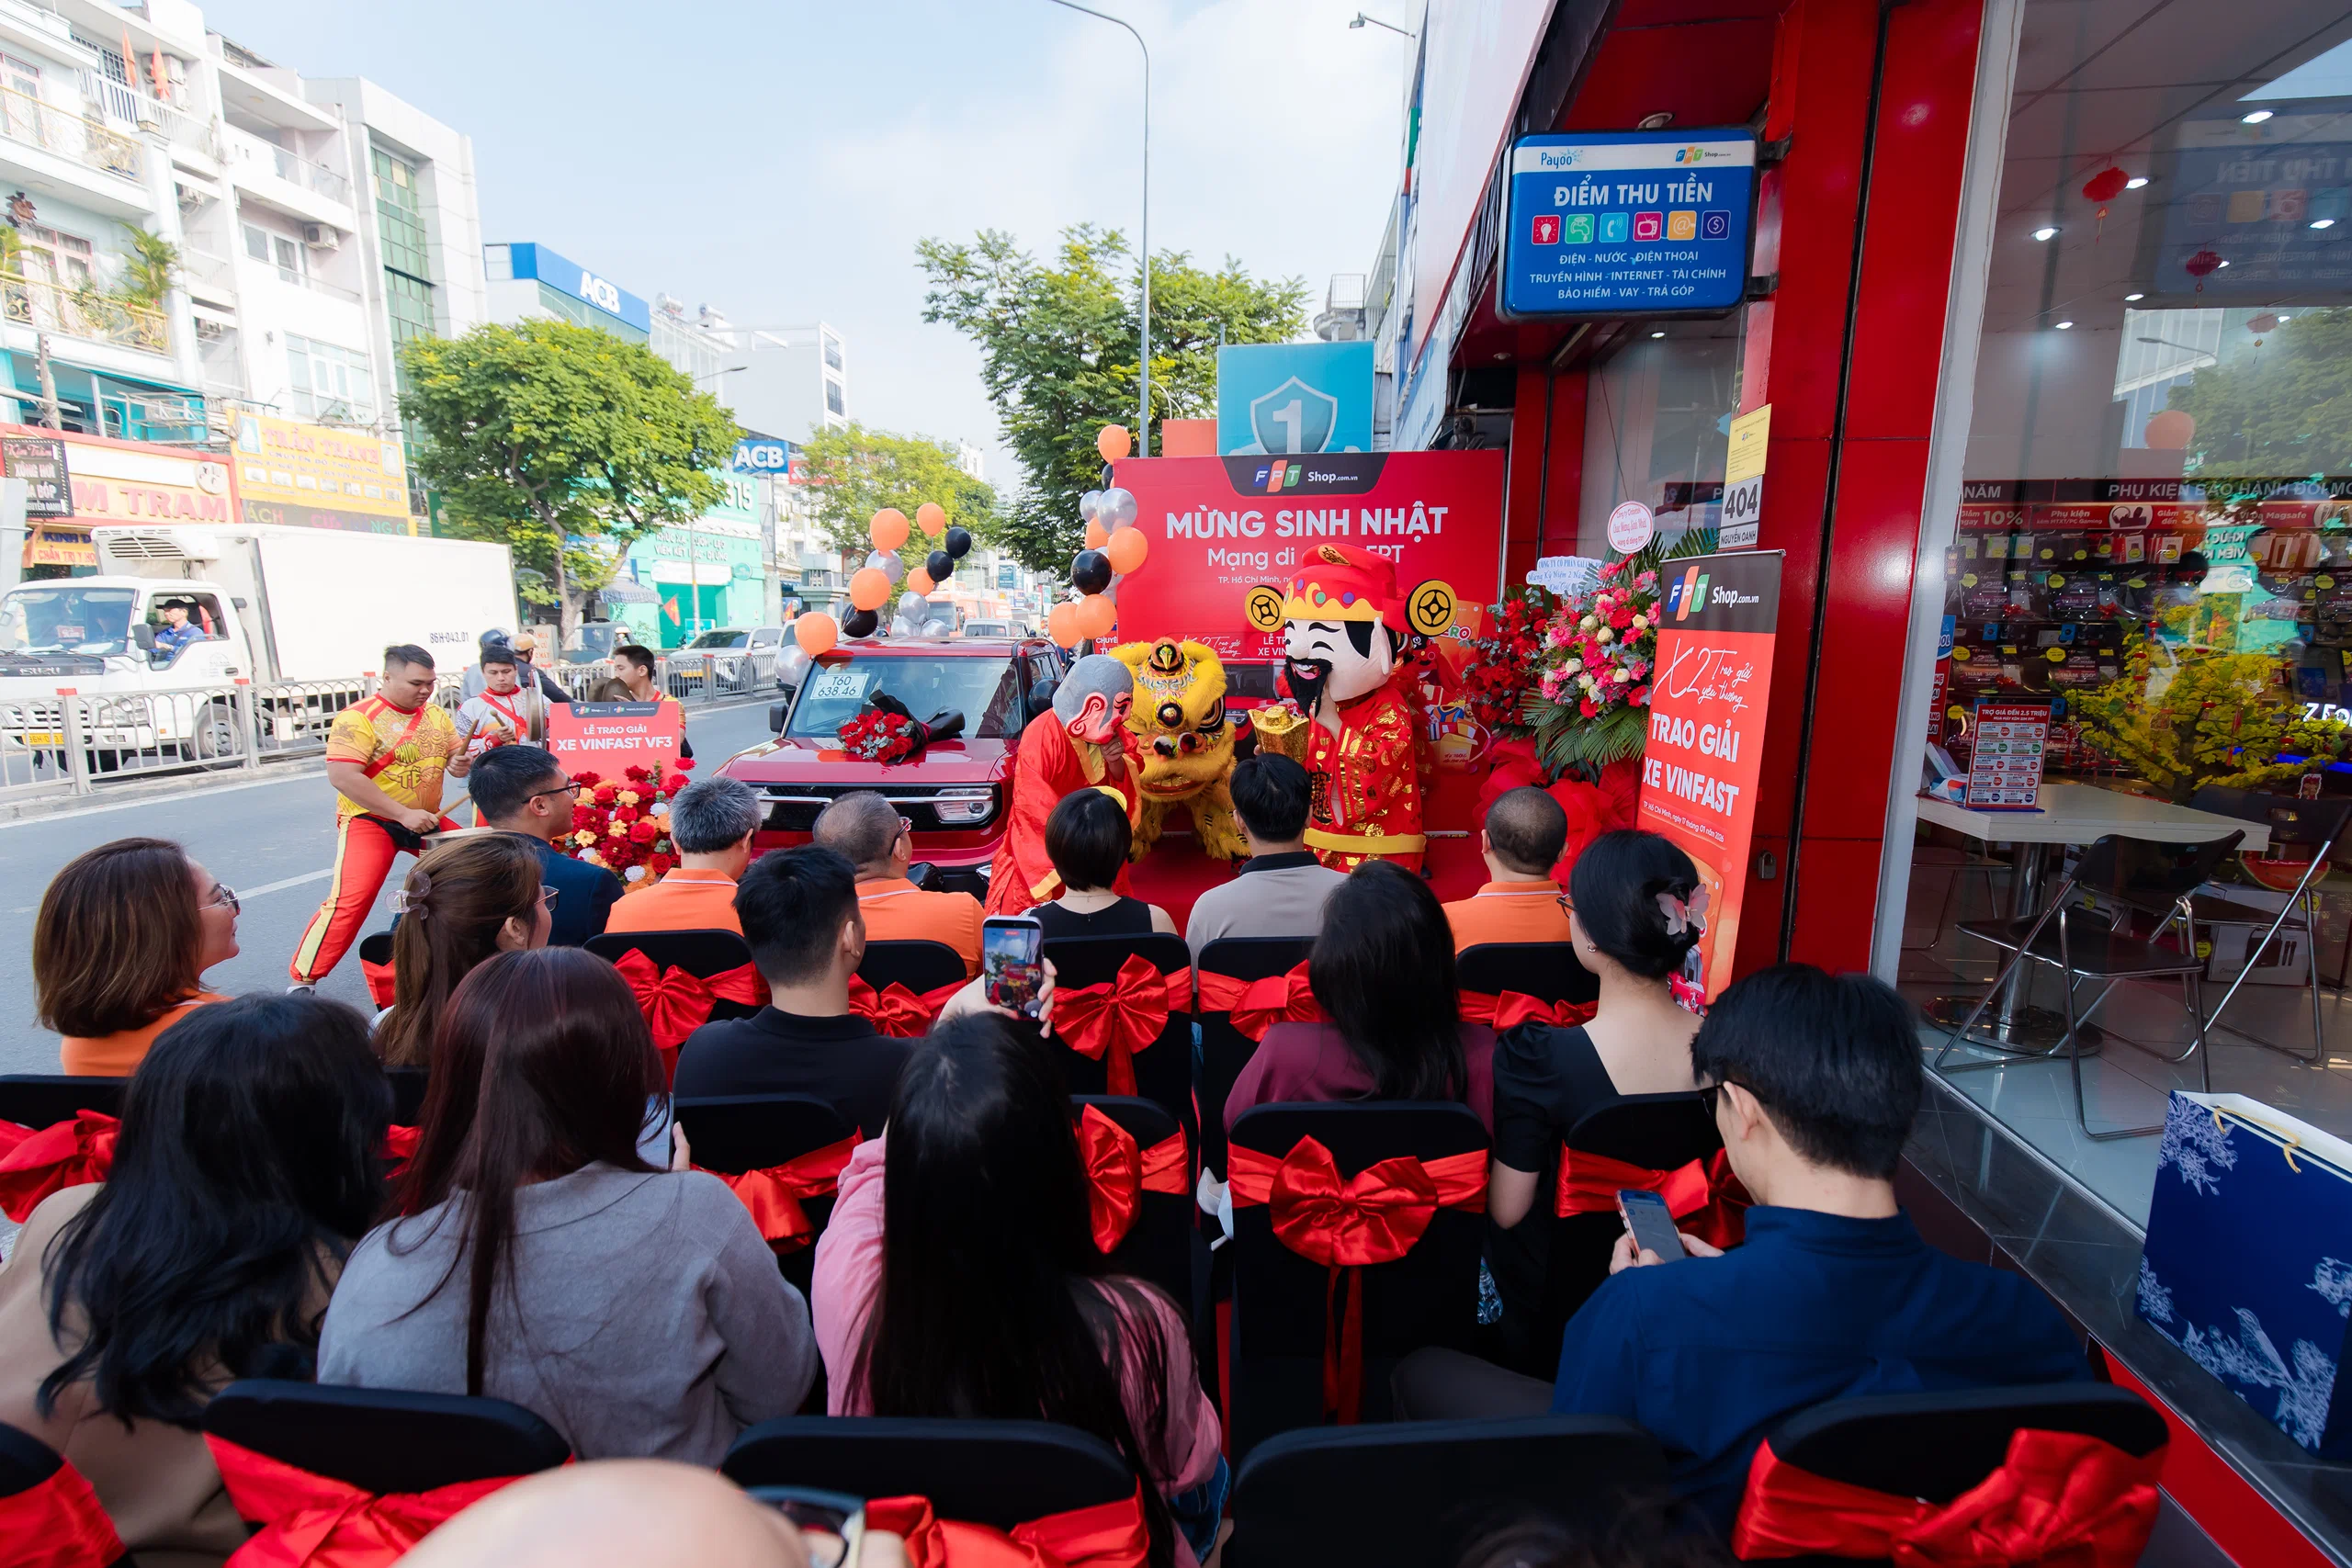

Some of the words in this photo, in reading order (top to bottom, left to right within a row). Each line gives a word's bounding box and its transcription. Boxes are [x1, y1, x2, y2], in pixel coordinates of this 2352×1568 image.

[1541, 152, 1572, 169] Payoo
[1554, 174, 1609, 207] ĐIỂM
[1616, 184, 1659, 205] THU
[1667, 172, 1713, 203] TIỀN
[1559, 253, 1586, 266] ĐIỆN
[1595, 252, 1627, 263] NƯỚC
[1635, 251, 1662, 264] ĐIỆN
[1665, 251, 1699, 264] THOẠI
[1575, 270, 1602, 281] HÌNH
[1611, 270, 1664, 280] INTERNET
[1672, 268, 1689, 278] TÀI
[1691, 267, 1726, 278] CHÍNH
[580, 271, 620, 314] ACB
[1558, 287, 1580, 299] BẢO
[1619, 288, 1640, 297] VAY
[1647, 284, 1668, 296] TRẢ
[1671, 284, 1695, 296] GÓP
[736, 445, 785, 468] ACB
[1307, 471, 1358, 484] Shop.com.vn
[1964, 483, 2001, 499] NĂM
[2109, 484, 2143, 502] PHỤ
[2149, 481, 2189, 500] KIỆN
[1724, 484, 1758, 519] 404
[1983, 510, 2023, 525] 10%
[2051, 510, 2068, 518] Phụ
[2070, 510, 2090, 518] kiện
[2266, 512, 2307, 521] Magsafe
[1166, 504, 1266, 539] MỪNG
[1275, 508, 1350, 537] SINH
[1361, 501, 1449, 543] NHẬT
[1741, 530, 1757, 542] OANH
[1207, 548, 1269, 570] Mạng
[1275, 547, 1295, 566] di
[1218, 576, 1230, 584] TP.
[1231, 574, 1243, 584] Hồ
[1245, 574, 1258, 584] Chí
[1260, 575, 1281, 584] Minh,
[1712, 586, 1759, 607] Shop.com.vn
[1258, 648, 1270, 656] XE
[832, 676, 852, 686] T60
[818, 686, 856, 697] 638.46
[584, 724, 594, 735] LỄ
[596, 726, 624, 734] TRAO
[626, 723, 647, 734] GIẢI
[557, 739, 577, 751] XE
[580, 738, 642, 750] VINFAST
[645, 736, 673, 748] VF3
[1652, 712, 1696, 750] TRAO
[1699, 718, 1740, 762] GIẢI
[1643, 756, 1663, 789] XE
[1666, 763, 1740, 817] VINFAST
